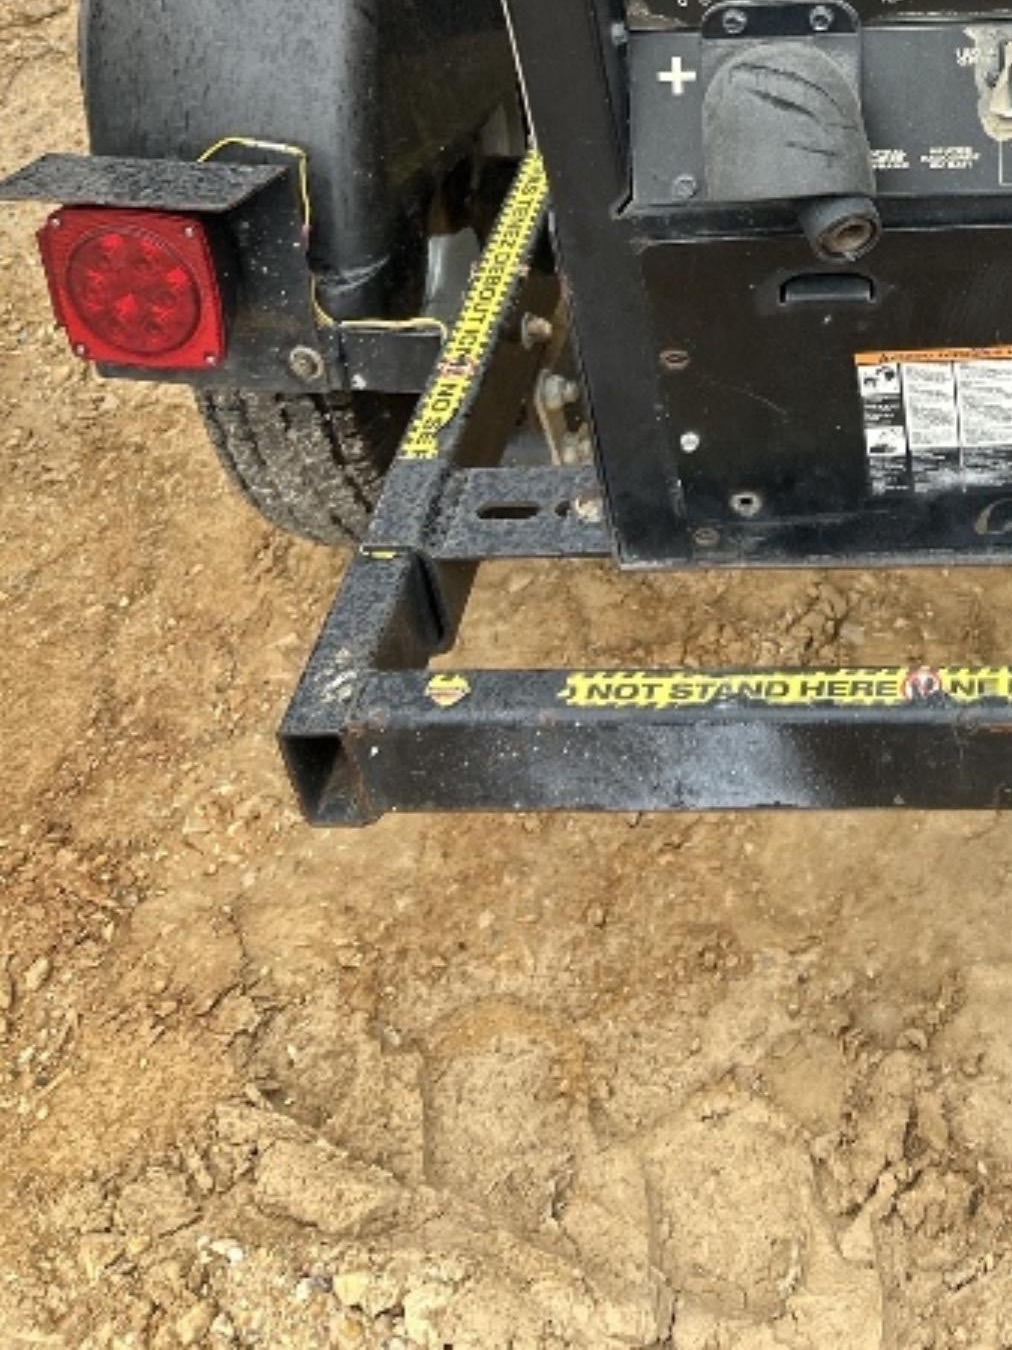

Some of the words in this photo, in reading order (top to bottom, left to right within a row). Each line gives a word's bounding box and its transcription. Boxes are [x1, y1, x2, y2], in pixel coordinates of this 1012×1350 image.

[586, 683, 663, 700] NOT
[669, 681, 791, 699] STAND
[799, 679, 898, 697] HERE
